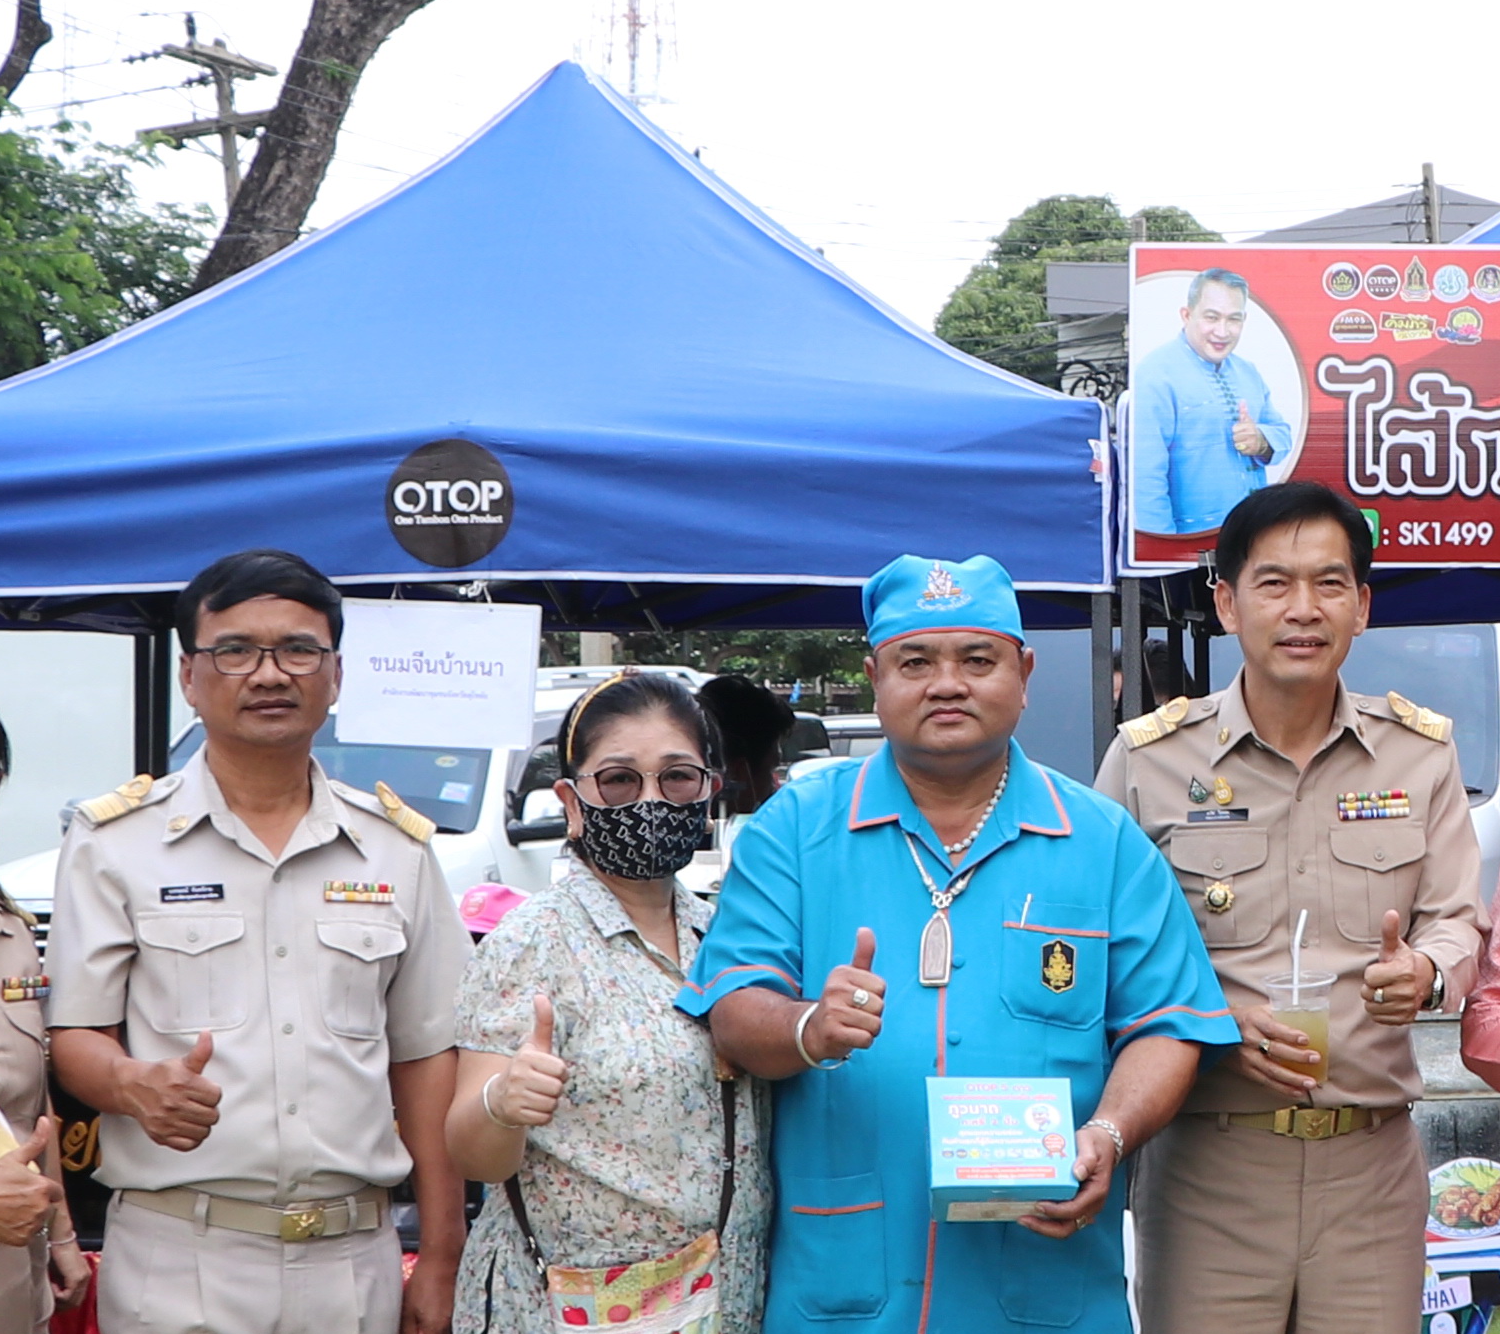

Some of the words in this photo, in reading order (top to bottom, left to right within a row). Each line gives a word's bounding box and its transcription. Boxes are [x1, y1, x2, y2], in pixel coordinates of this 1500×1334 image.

[393, 479, 504, 514] OTOP
[1397, 520, 1495, 546] SK1499
[369, 651, 504, 677] ขนมจีนบ้านนา
